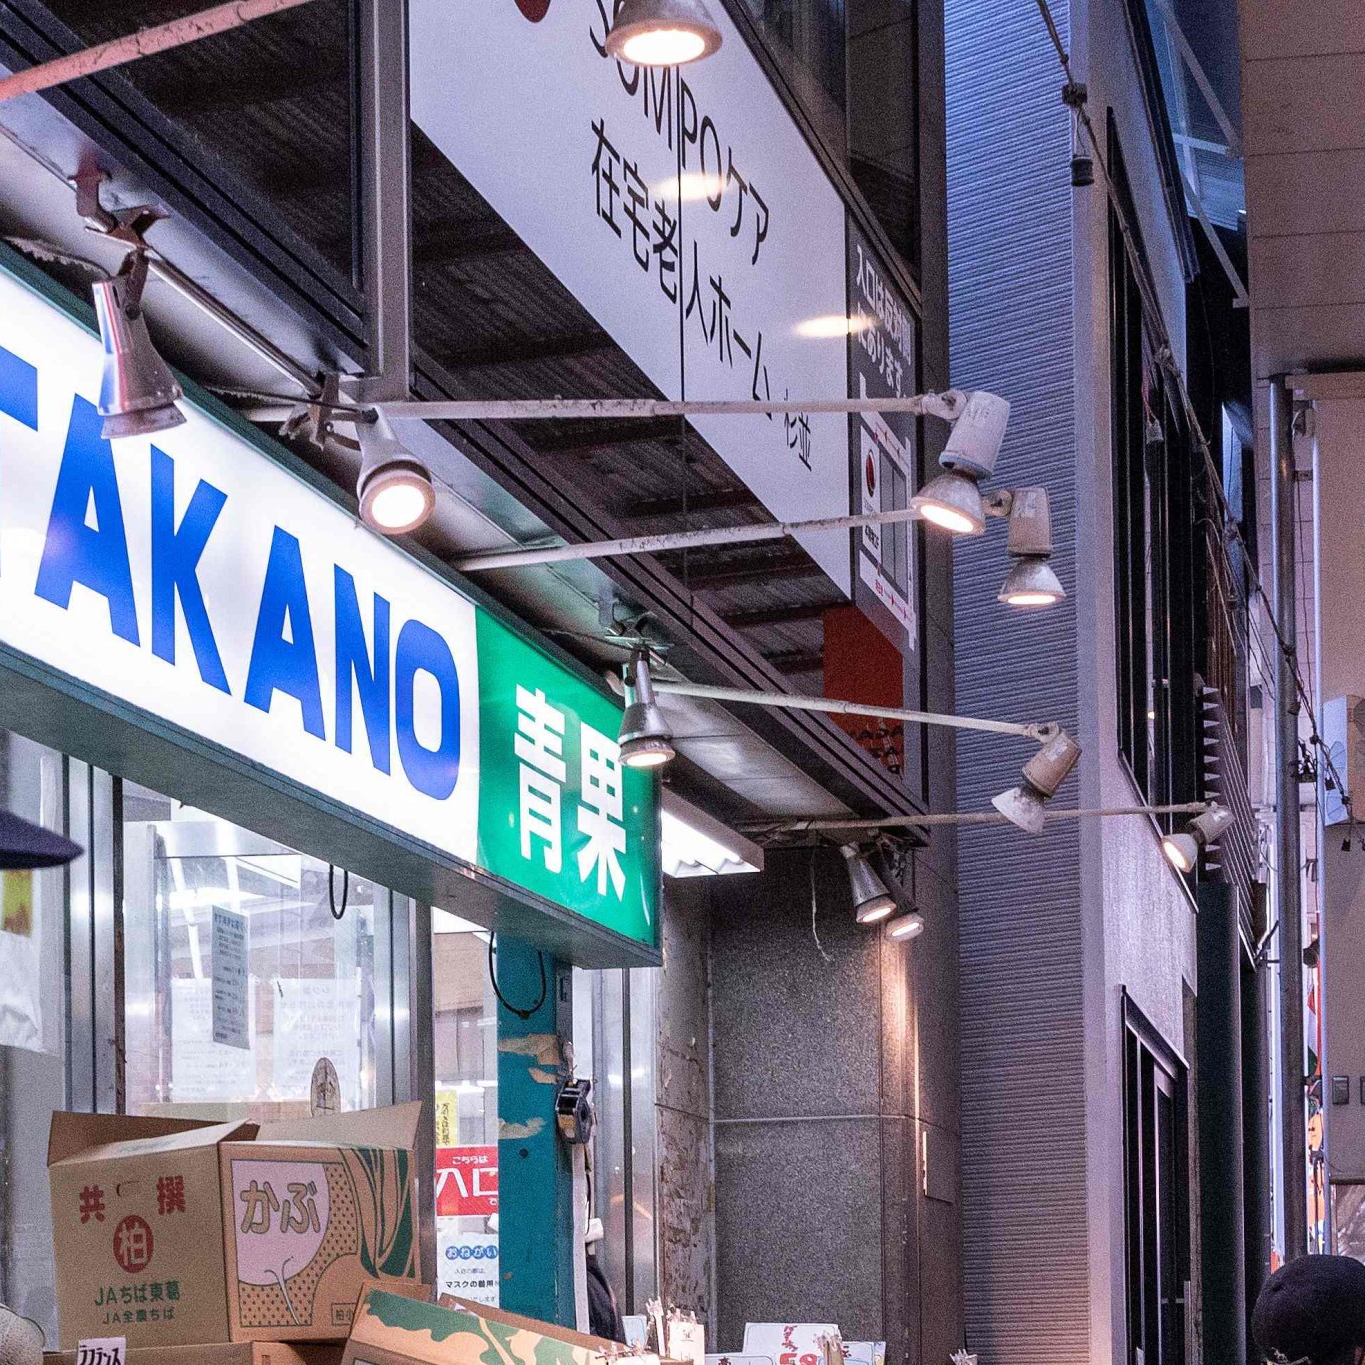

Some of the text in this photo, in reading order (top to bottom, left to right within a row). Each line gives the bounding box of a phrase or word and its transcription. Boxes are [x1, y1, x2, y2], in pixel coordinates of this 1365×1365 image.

[591, 117, 773, 420] 在宅老人ホーム
[514, 685, 628, 904] 青果
[452, 1155, 488, 1165] こちらは
[79, 1175, 186, 1224] 共 撰
[240, 1179, 322, 1234] かぶ
[445, 1245, 498, 1261] おねがい
[95, 1279, 181, 1306] JAちば東葛
[103, 1307, 176, 1325] JA全農ちば
